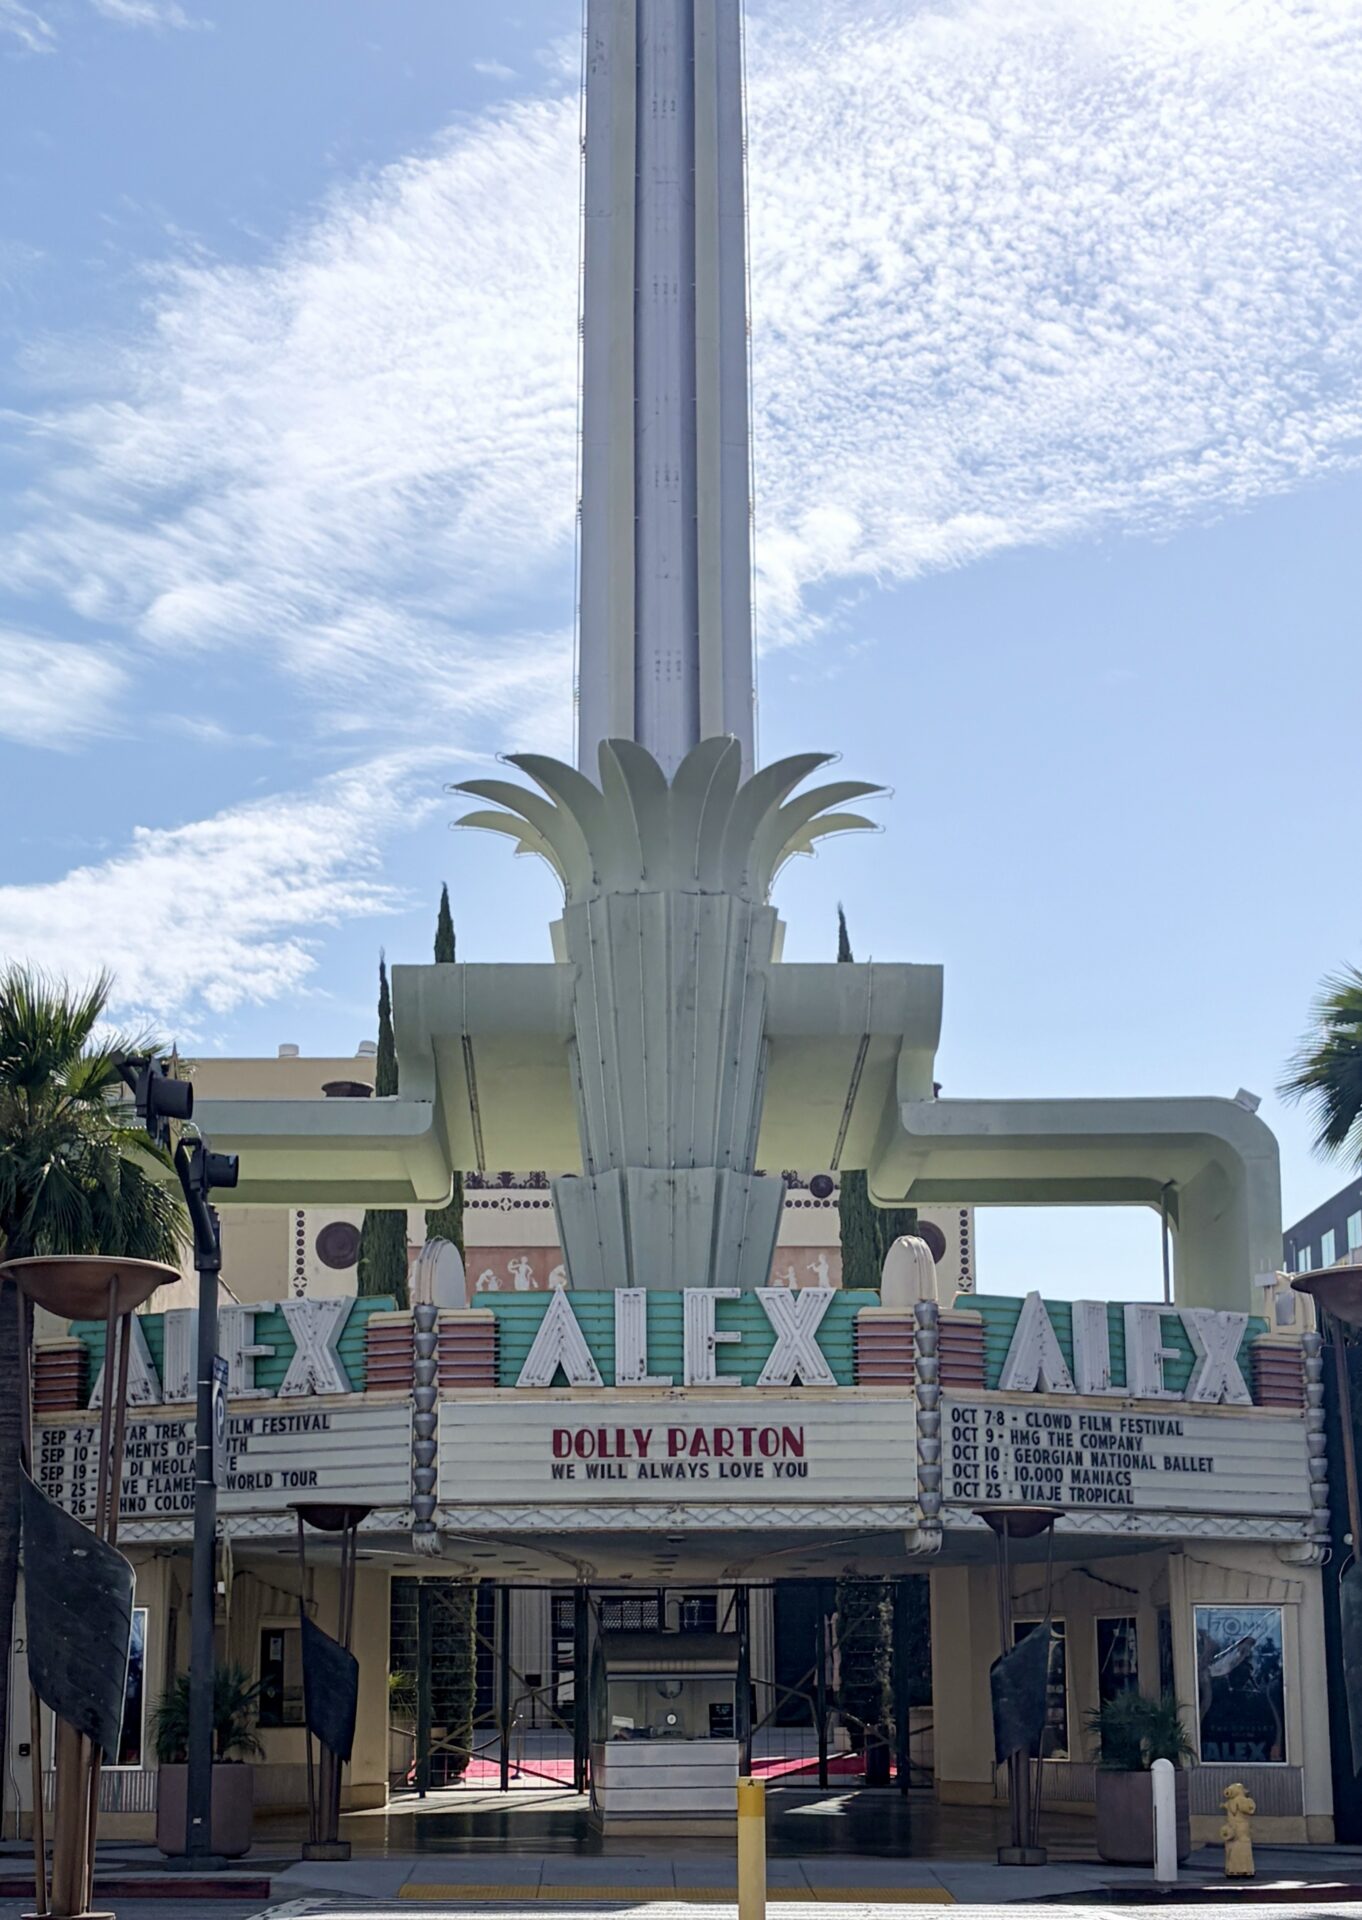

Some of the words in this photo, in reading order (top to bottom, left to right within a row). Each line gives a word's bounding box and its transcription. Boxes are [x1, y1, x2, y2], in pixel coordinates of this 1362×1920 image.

[515, 1285, 838, 1387] ALEX
[1000, 1290, 1254, 1405] ALEX
[88, 1296, 356, 1410] ALEX
[226, 1419, 253, 1435] ILM
[262, 1414, 330, 1433] FESTIVAL
[951, 1407, 977, 1424] OCT
[1079, 1415, 1112, 1432] FILM
[1120, 1418, 1184, 1436] FESTIVAL
[41, 1430, 66, 1446] SEP
[73, 1428, 94, 1444] 4-7
[115, 1426, 147, 1441] TAR
[155, 1423, 186, 1439] TREK
[553, 1428, 653, 1458] DOLLY
[668, 1426, 804, 1457] PARTON
[952, 1426, 978, 1442] OCT
[986, 1428, 994, 1443] 9
[1010, 1429, 1040, 1446] HMG
[1047, 1431, 1074, 1447] THE
[1080, 1433, 1143, 1451] COMPANY
[41, 1449, 64, 1463] SEP
[74, 1447, 88, 1462] 10
[110, 1441, 168, 1458] MENTS
[177, 1441, 194, 1456] OF
[952, 1444, 978, 1461] OCT
[985, 1446, 1000, 1461] 10
[1014, 1447, 1084, 1466] GEORGIAN
[1091, 1451, 1157, 1470] NATIONAL
[1163, 1455, 1214, 1473] BALLET
[40, 1466, 64, 1481] SEP
[73, 1465, 86, 1479] 19
[130, 1461, 143, 1476] DI
[152, 1459, 196, 1475] MEOLA
[226, 1472, 273, 1490] WORLD
[281, 1470, 318, 1487] TOUR
[551, 1463, 575, 1479] WE
[585, 1463, 628, 1479] WILL
[637, 1462, 709, 1479] ALWAYS
[719, 1462, 764, 1478] LOVE
[772, 1461, 808, 1478] YOU
[952, 1463, 979, 1479] OCT
[985, 1464, 999, 1480] 16
[1071, 1469, 1132, 1486] MANIACS
[42, 1483, 63, 1498] EP
[71, 1483, 86, 1498] 25
[953, 1482, 979, 1498] OCT
[985, 1482, 1001, 1499] 25
[1020, 1484, 1062, 1502] VIAJE
[1069, 1487, 1134, 1505] TROPICAL
[71, 1500, 86, 1515] 26
[1205, 1741, 1267, 1761] ALEX
